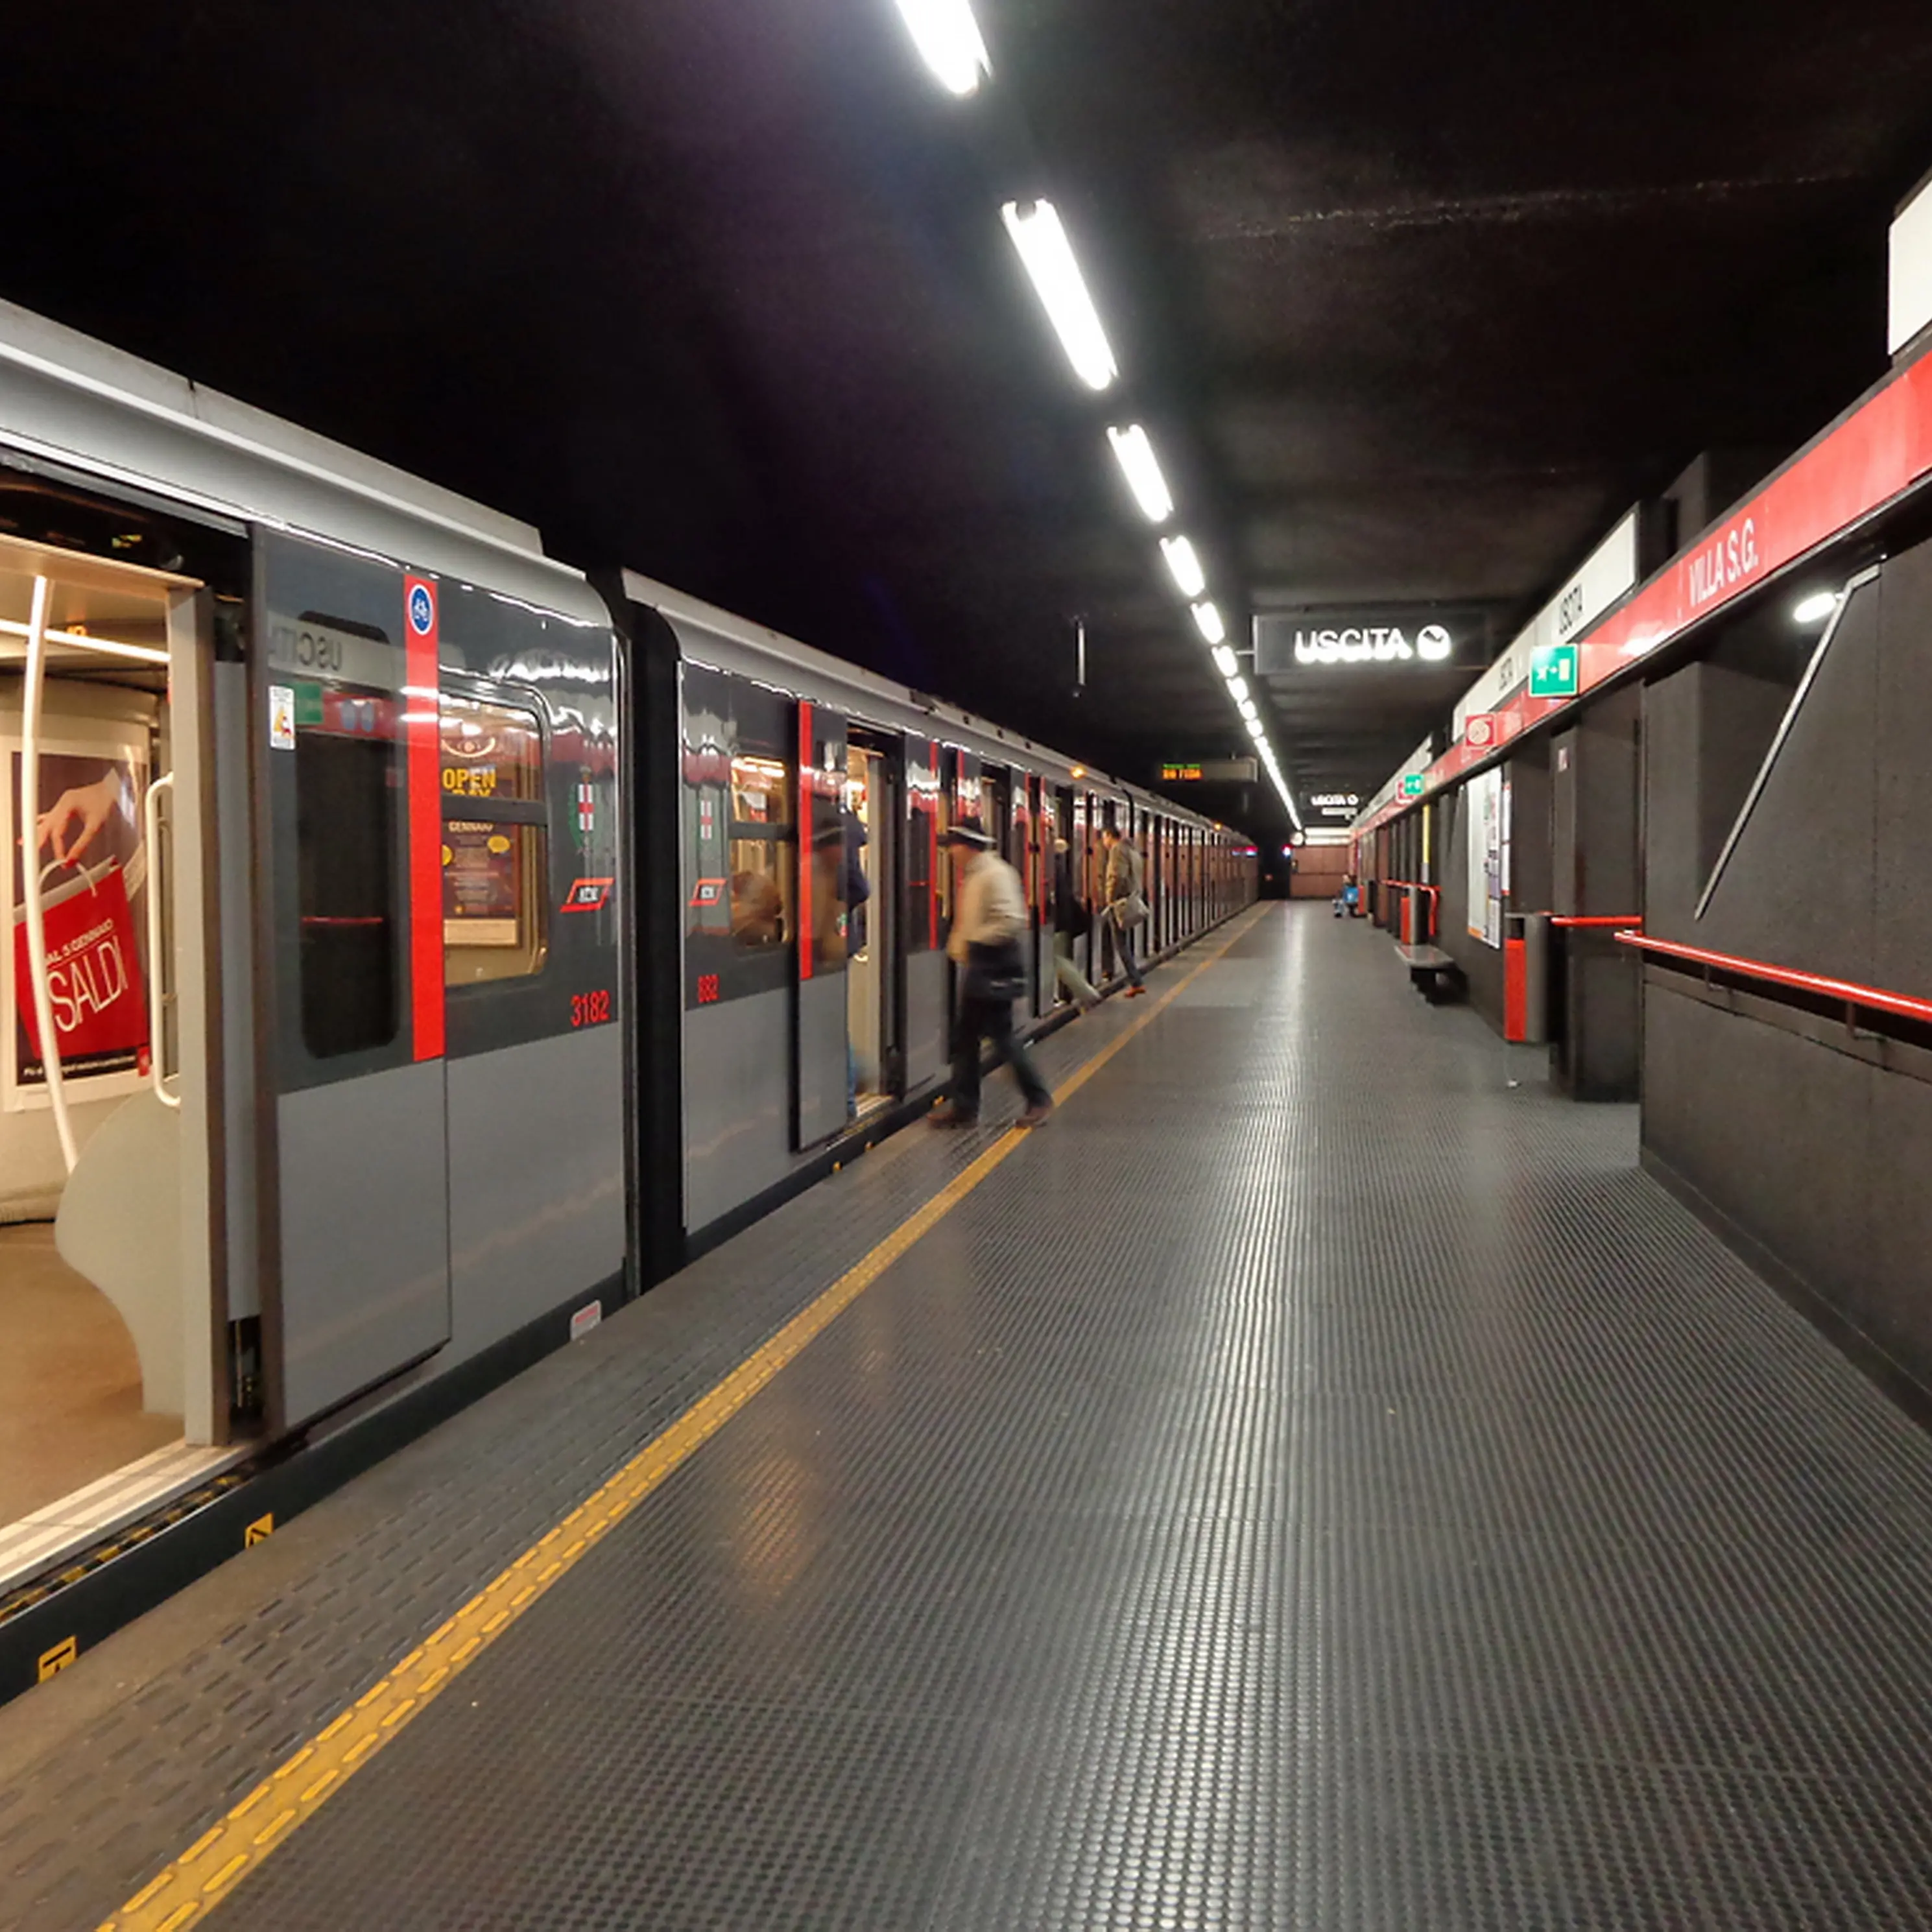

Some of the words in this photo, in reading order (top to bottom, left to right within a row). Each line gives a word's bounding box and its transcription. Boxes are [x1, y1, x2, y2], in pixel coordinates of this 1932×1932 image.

[1689, 542, 1725, 608] VILLA
[1727, 518, 1759, 583] S.G.
[1294, 628, 1413, 663] USCITA
[442, 767, 496, 789] OPEN
[48, 934, 128, 1032] SALDI
[570, 989, 610, 1027] 3182
